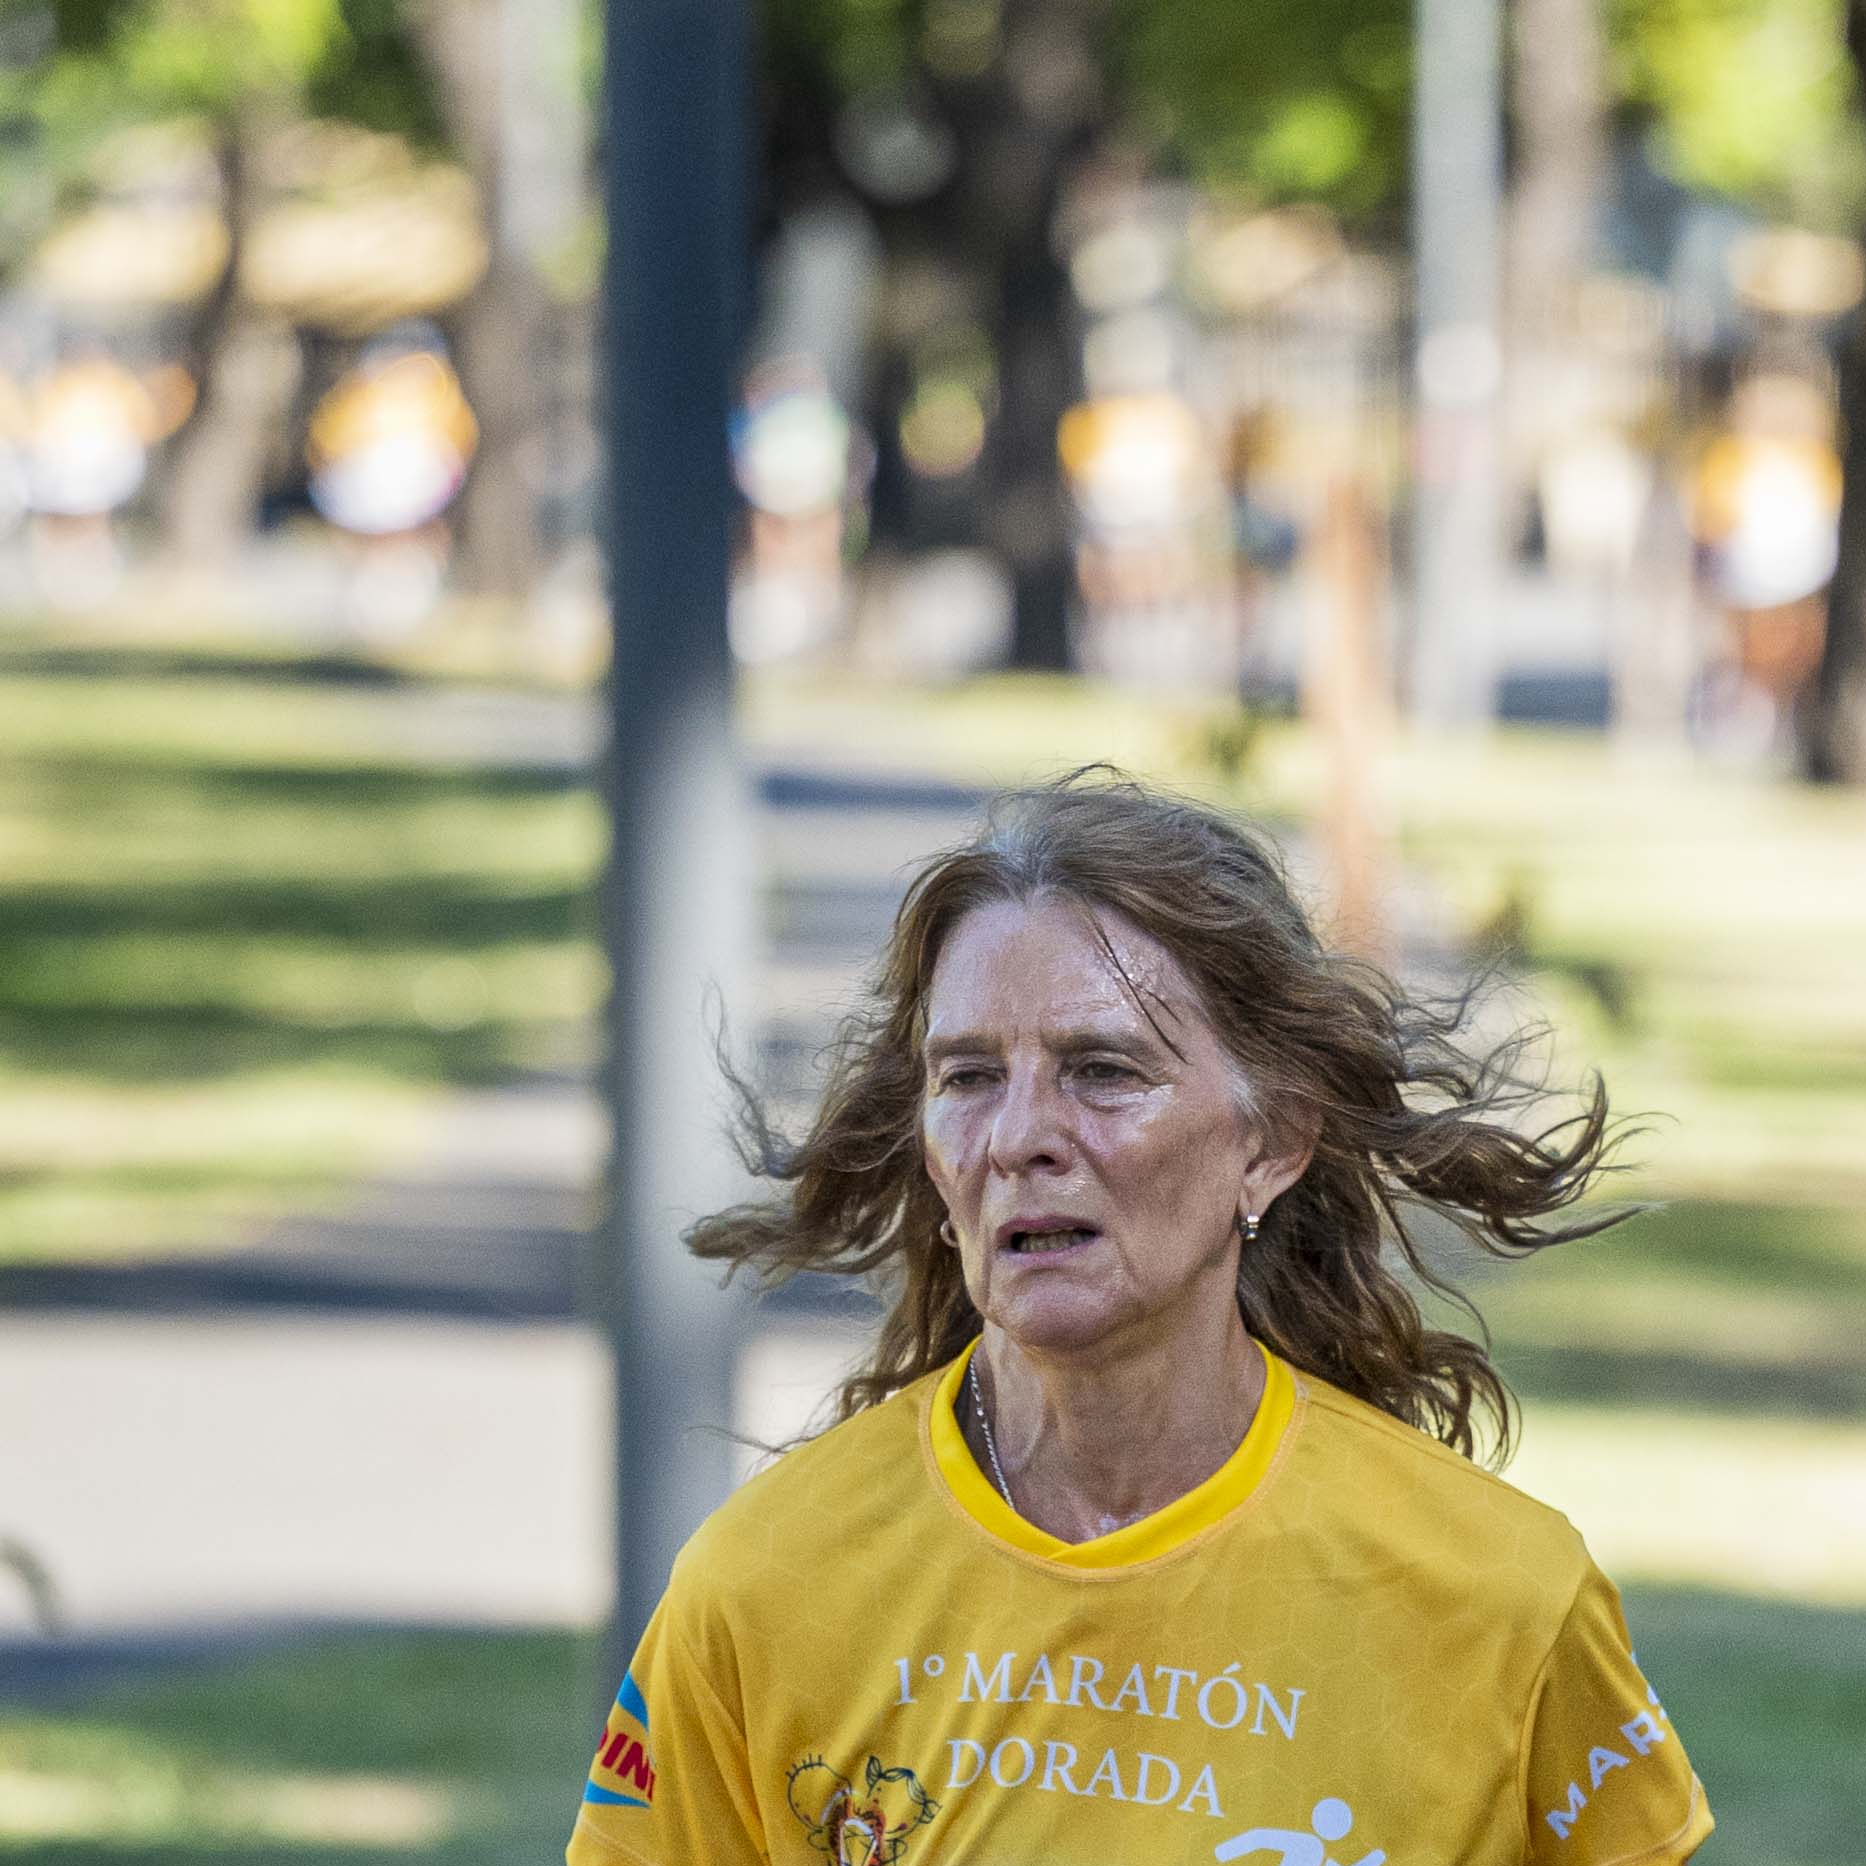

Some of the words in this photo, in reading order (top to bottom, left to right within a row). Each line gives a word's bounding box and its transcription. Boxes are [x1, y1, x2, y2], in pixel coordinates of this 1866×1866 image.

[957, 1651, 1306, 1740] MARATÓN
[944, 1735, 1225, 1818] DORADA
[1545, 1686, 1667, 1839] MAR
